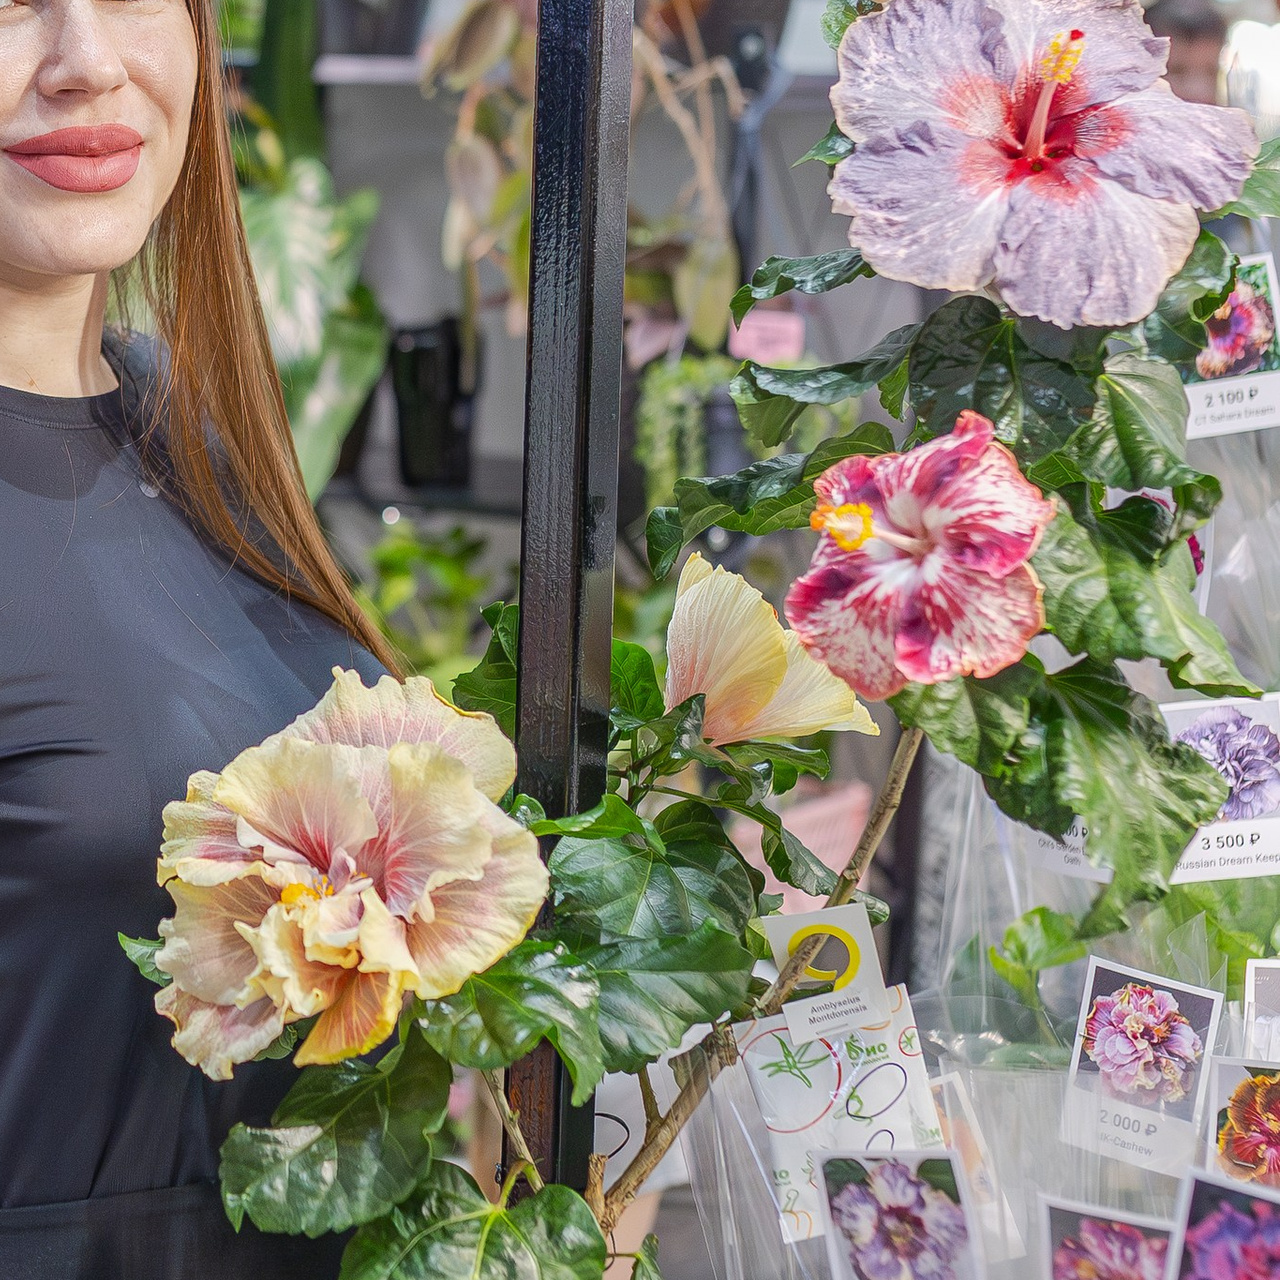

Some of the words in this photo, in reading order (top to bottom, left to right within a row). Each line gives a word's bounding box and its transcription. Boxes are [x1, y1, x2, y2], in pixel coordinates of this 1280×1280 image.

[1201, 837, 1211, 851] 3
[1216, 834, 1245, 849] 500
[1250, 832, 1261, 846] ₽
[1219, 855, 1253, 867] Dream
[810, 995, 862, 1015] Amblyseius
[1099, 1109, 1109, 1124] 2
[1112, 1113, 1141, 1134] 000
[1144, 1123, 1158, 1136] ₽
